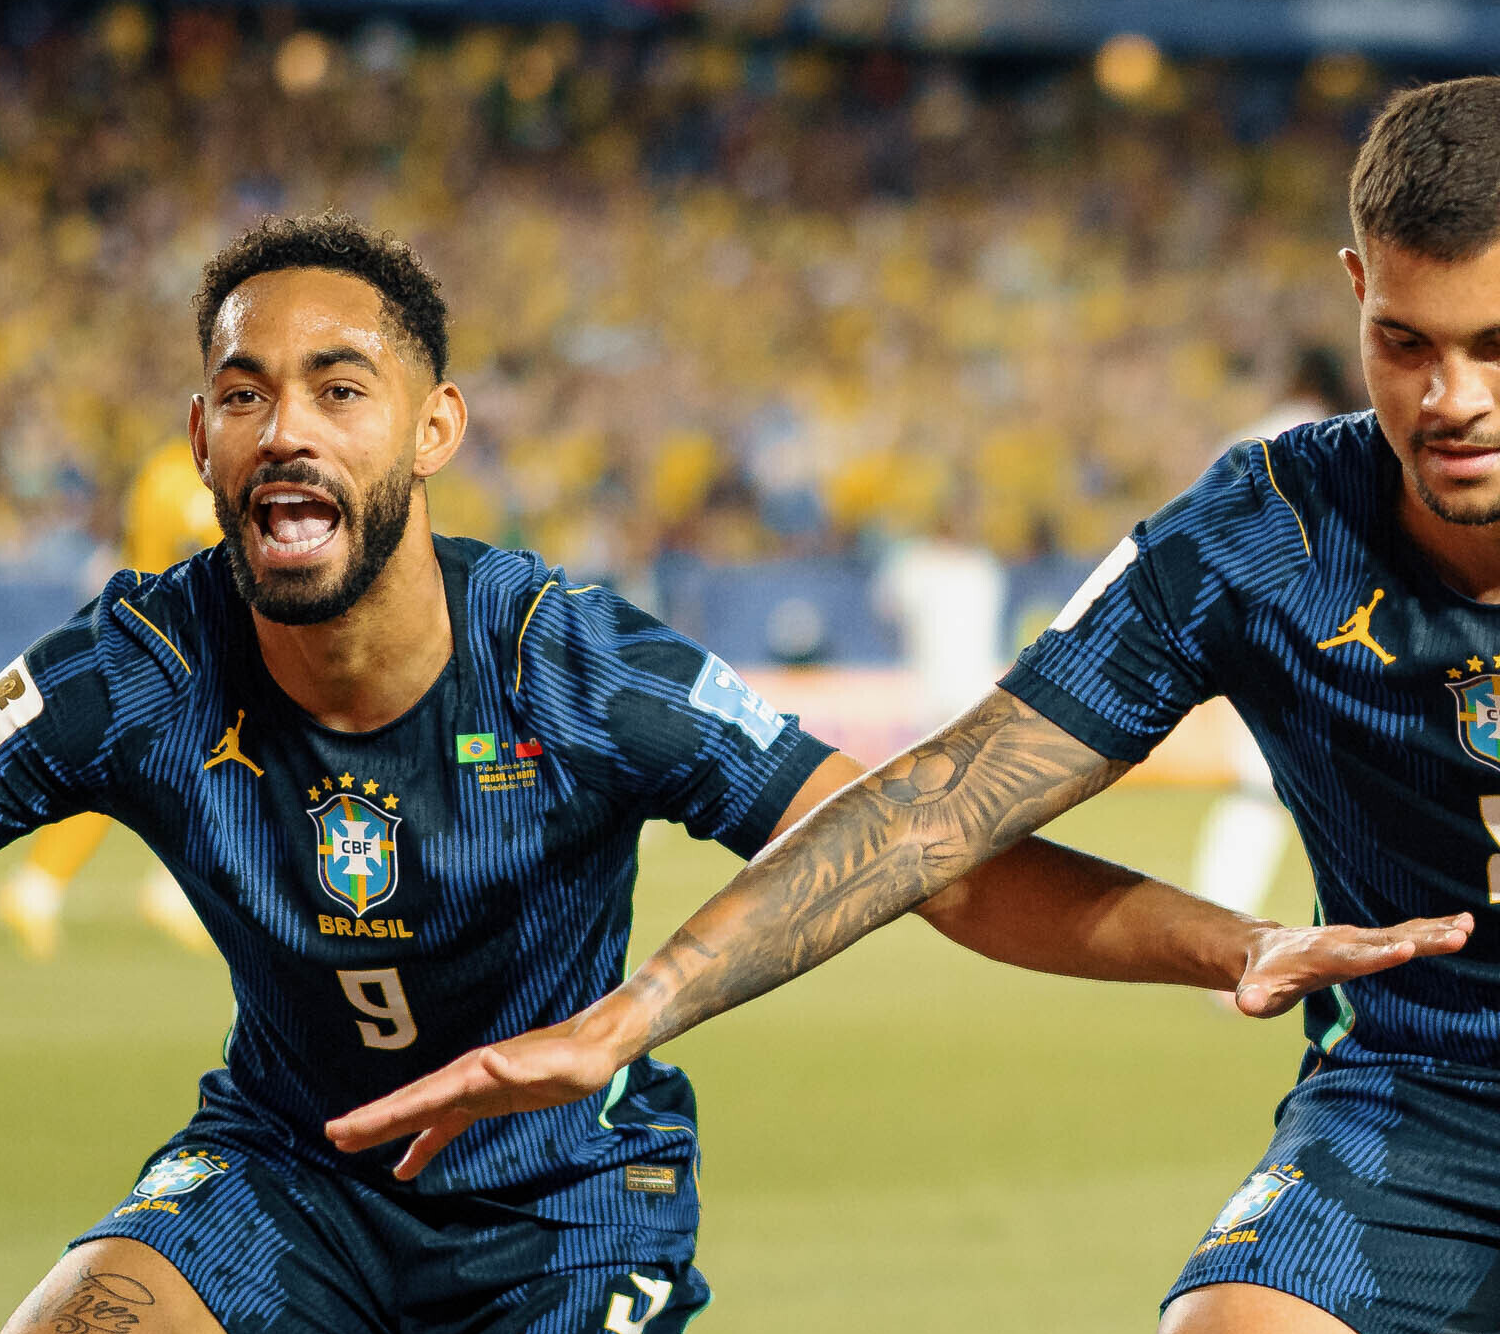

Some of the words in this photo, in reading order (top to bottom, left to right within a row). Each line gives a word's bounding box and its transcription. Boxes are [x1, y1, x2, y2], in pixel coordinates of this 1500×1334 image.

[478, 773, 506, 783] BRASIL
[341, 839, 372, 855] CBF
[317, 914, 414, 939] BRASIL
[336, 967, 418, 1050] 9
